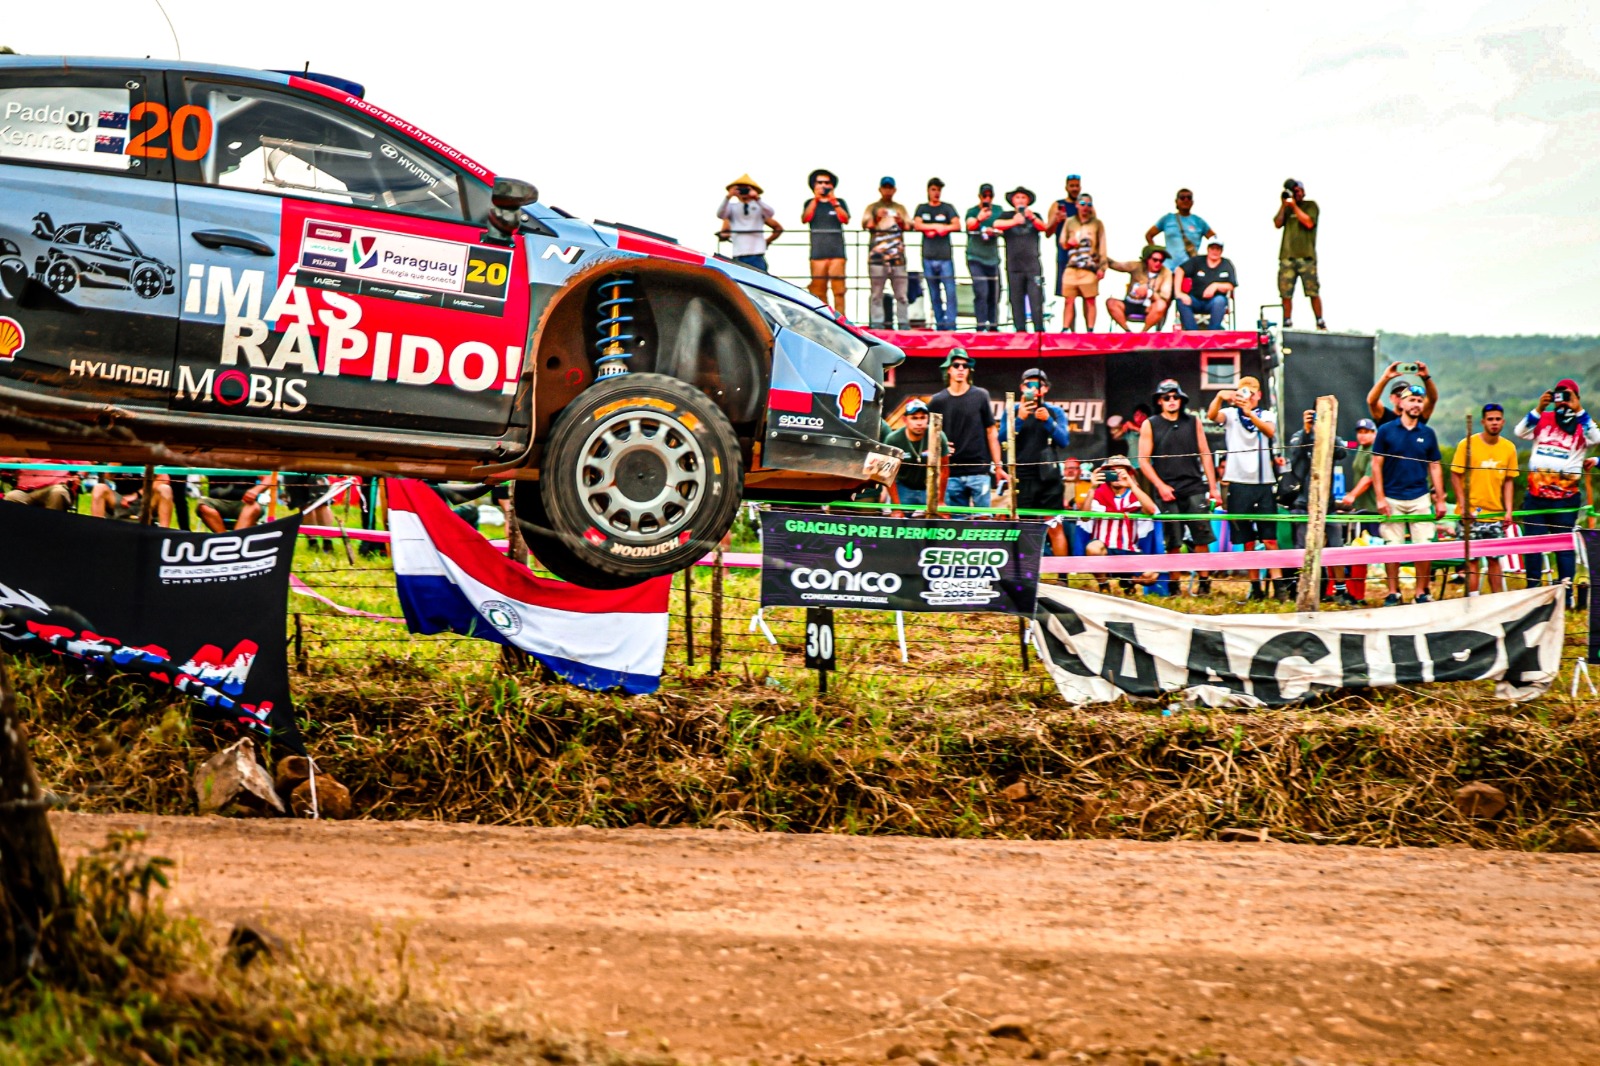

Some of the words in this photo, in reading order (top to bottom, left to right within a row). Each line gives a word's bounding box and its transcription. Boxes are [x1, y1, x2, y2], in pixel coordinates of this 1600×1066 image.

[4, 101, 94, 128] Paddon
[125, 102, 213, 161] 20
[345, 96, 488, 177] motorsport.hyundai.com
[397, 156, 440, 188] HYUNDAI
[383, 250, 458, 276] Paraguay
[466, 259, 508, 286] 20
[313, 276, 342, 287] WRC
[411, 272, 425, 280] que
[426, 275, 457, 285] conecta
[69, 359, 170, 388] HYUNDAI
[174, 365, 308, 413] MOBIS
[779, 414, 824, 428] sparco
[785, 519, 847, 536] GRACIAS
[847, 524, 878, 538] POR
[879, 526, 895, 538] EL
[896, 526, 957, 540] PERMISO
[957, 528, 1006, 541] JEFEEE
[161, 530, 283, 563] WRC
[923, 549, 1004, 566] SERGIO
[162, 568, 273, 585] CHAMPIONSHIP
[185, 566, 229, 575] WORLD
[232, 558, 274, 572] RALLY
[927, 565, 997, 579] OJEDA
[943, 590, 975, 598] 2026
[806, 622, 832, 661] 30
